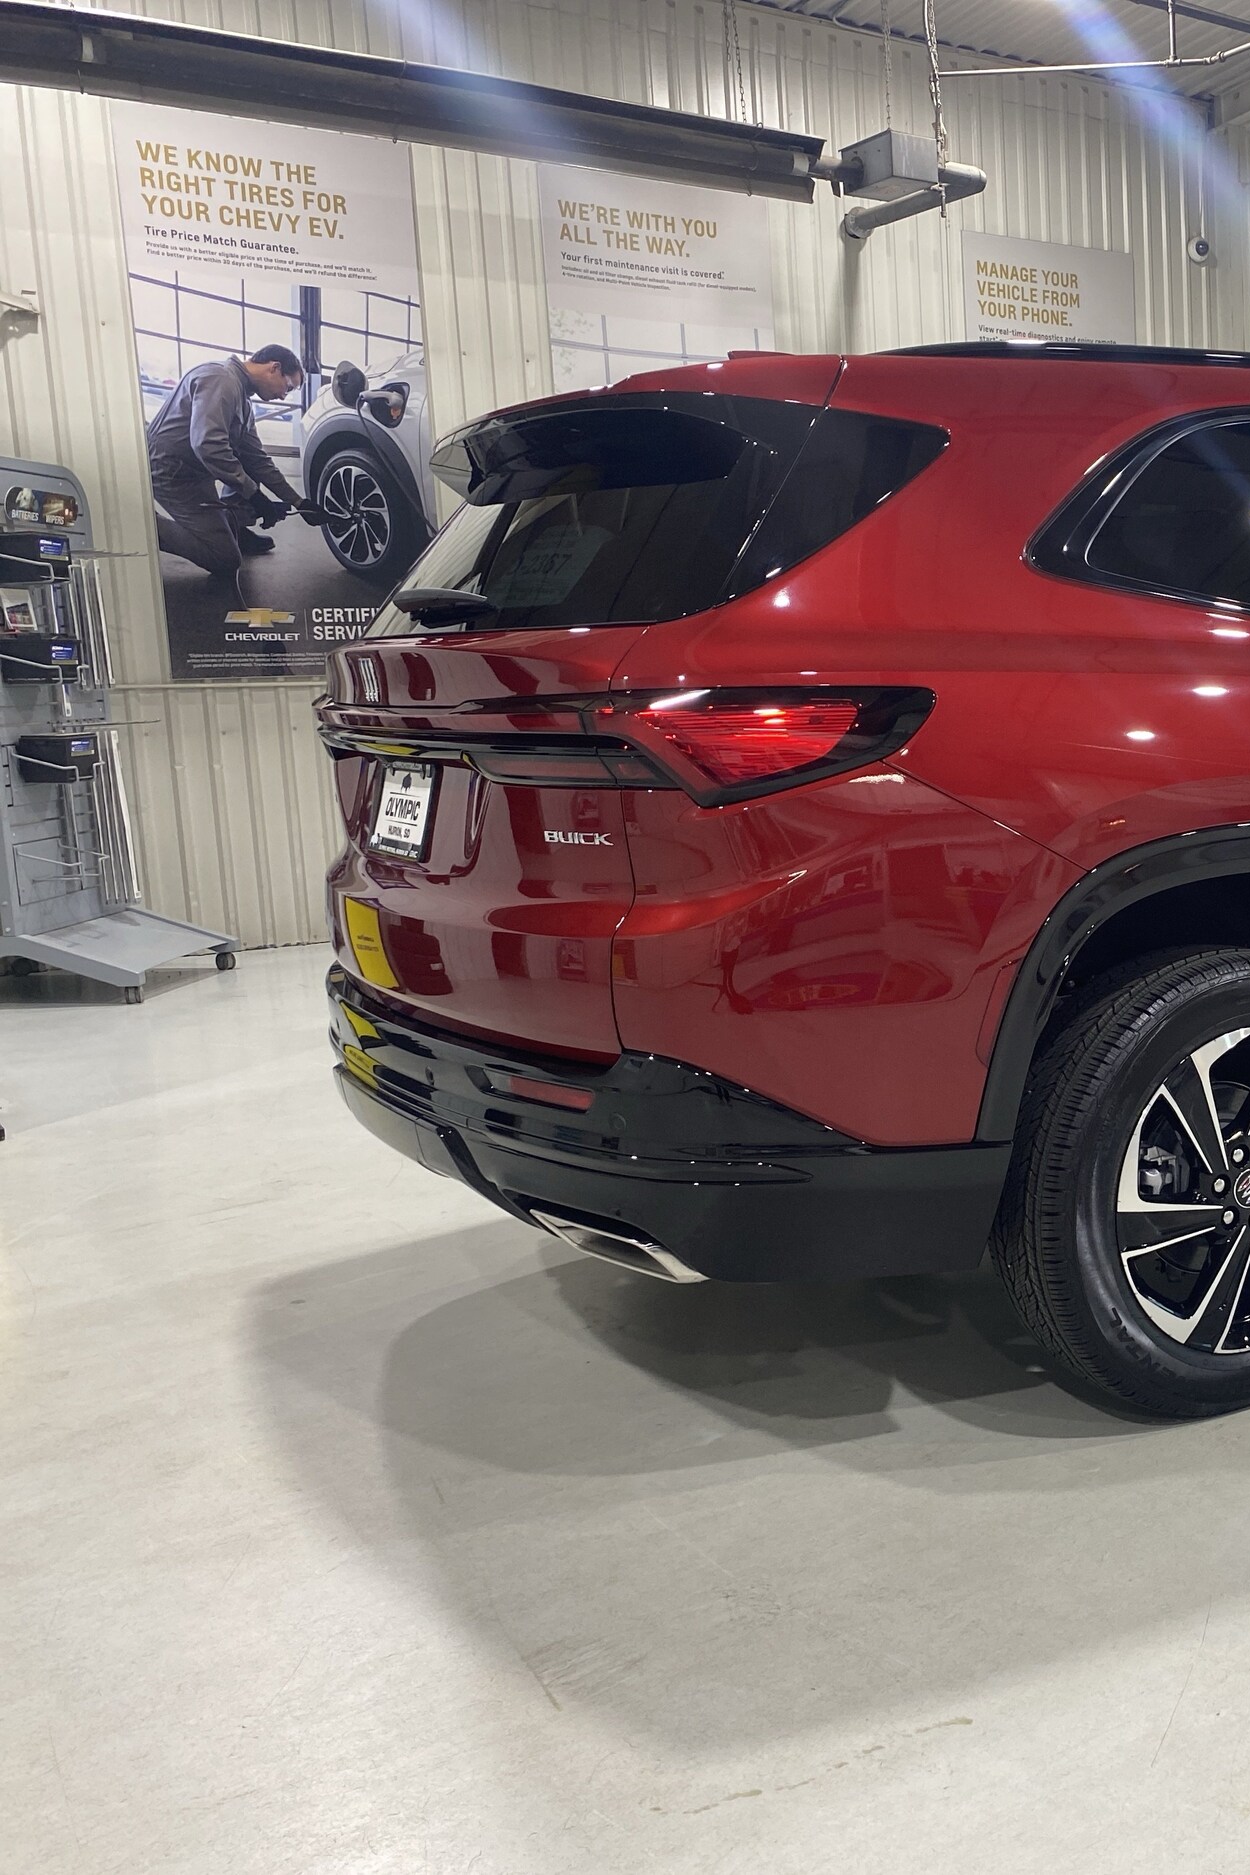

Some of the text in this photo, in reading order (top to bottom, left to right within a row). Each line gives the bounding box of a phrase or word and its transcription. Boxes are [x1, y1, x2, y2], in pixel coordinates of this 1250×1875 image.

[136, 140, 316, 185] WE KNOW THE
[140, 167, 347, 214] RIGHT TIRES FOR
[141, 194, 344, 240] YOUR CHEVY EV.
[557, 199, 717, 238] WE'RE WITH YOU
[144, 225, 299, 254] Tire Price Match Guarantee.
[199, 248, 217, 256] better
[559, 223, 690, 257] ALL THE WAY.
[166, 251, 185, 259] better
[561, 251, 581, 263] Your
[583, 254, 602, 266] first
[605, 259, 660, 274] maintenance
[661, 265, 679, 276] visit
[681, 268, 688, 277] is
[976, 260, 1078, 289] MANAGE YOUR
[977, 279, 1080, 308] VEHICLE FROM
[977, 300, 1073, 327] YOUR PHONE.
[978, 324, 994, 333] View
[996, 327, 1026, 338] real-time
[1027, 330, 1063, 342] diagnostics
[11, 509, 39, 522] BATTERIES
[312, 608, 380, 623] CERTIFI
[225, 633, 300, 641] CHEVROLET
[313, 625, 368, 640] SERVI
[385, 797, 421, 821] OLYMPIC
[403, 828, 411, 838] SD
[544, 830, 613, 846] BUICK
